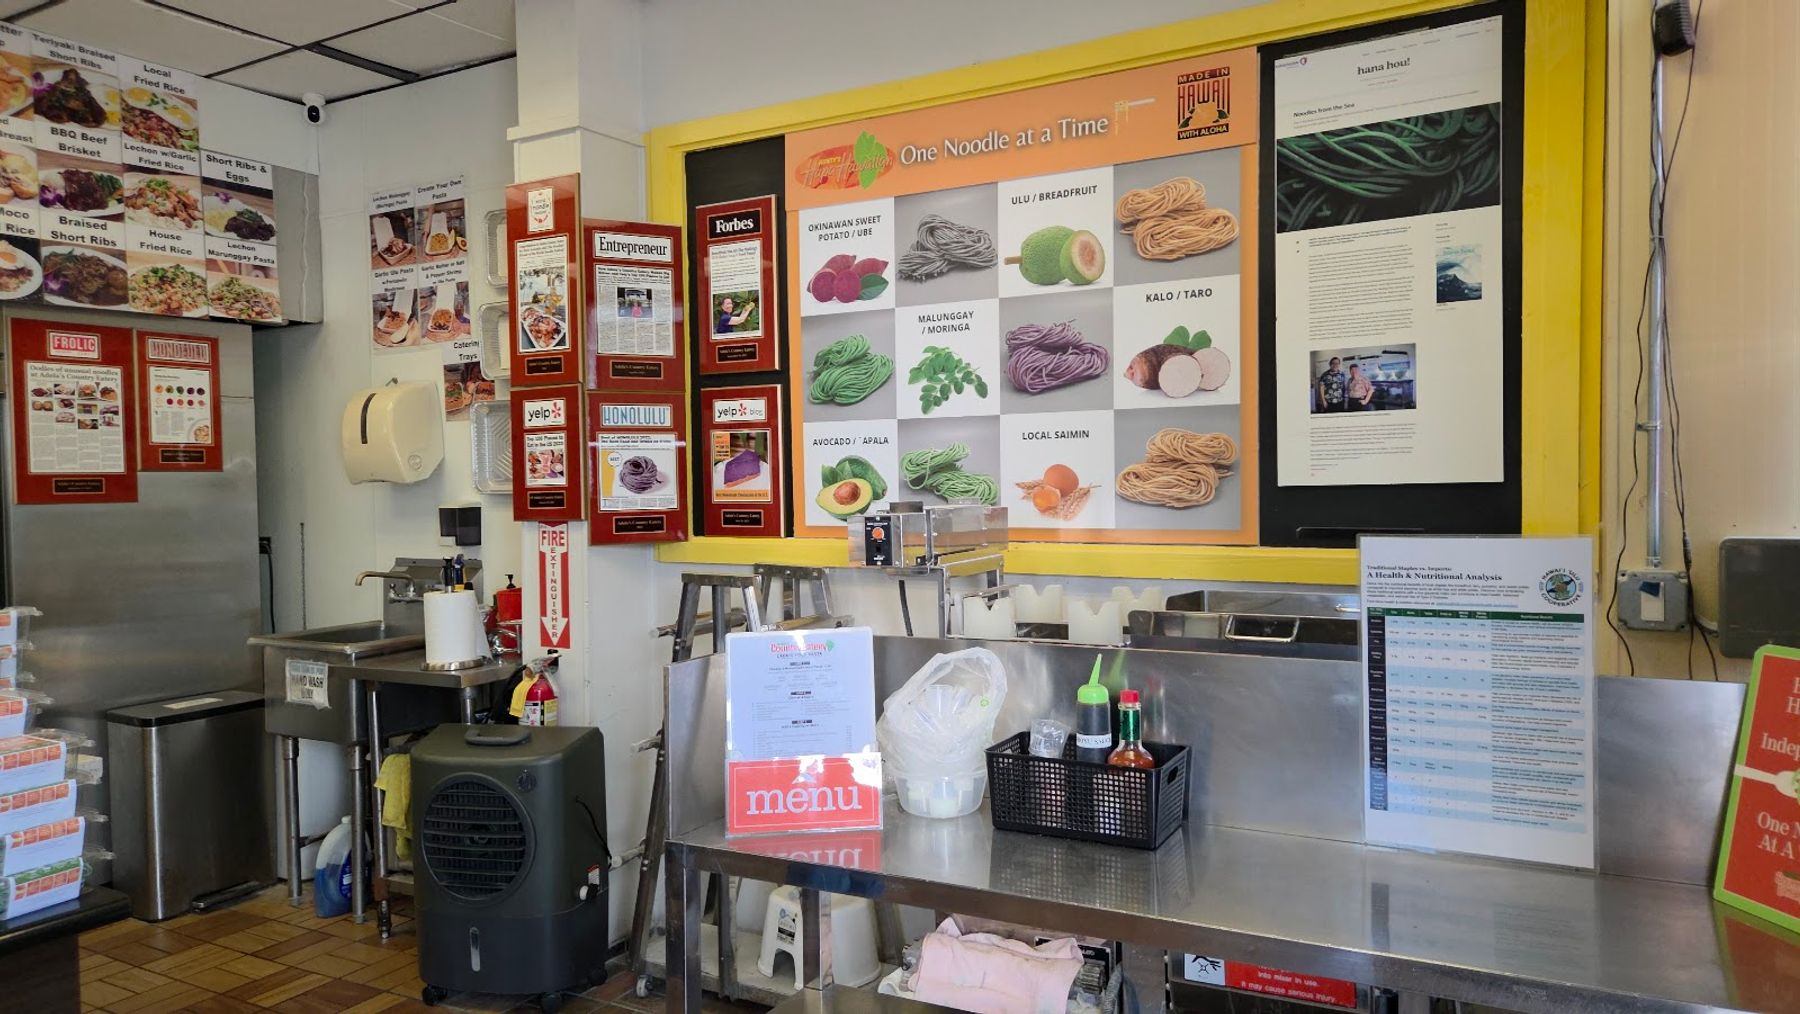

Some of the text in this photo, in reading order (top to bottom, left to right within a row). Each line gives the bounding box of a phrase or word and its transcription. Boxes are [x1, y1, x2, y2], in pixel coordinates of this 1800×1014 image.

[32, 33, 116, 62] Teriyaki Braised
[49, 50, 102, 70] Short Ribs
[1357, 57, 1411, 75] hana hou!
[143, 64, 172, 78] Local
[1178, 68, 1228, 83] MADE IN
[134, 75, 186, 95] Fried Rice
[1178, 78, 1230, 126] HAWAII
[1293, 107, 1317, 118] Noodles
[1318, 105, 1332, 113] from
[1343, 102, 1355, 110] Sea
[50, 127, 107, 145] BBQ Beef
[1179, 125, 1227, 139] WITH ALOHA
[901, 117, 1109, 165] One Noodle at a Time
[58, 143, 101, 158] Brisket
[124, 143, 158, 156] Lechon
[138, 157, 185, 171] Fried Rice
[206, 154, 267, 174] Short Ribs &
[225, 171, 250, 184] Eggs
[417, 186, 435, 194] Create
[435, 182, 449, 191] Your
[1011, 195, 1030, 205] ULU
[1039, 185, 1098, 201] BREADFRUIT
[432, 192, 447, 200] Pasta
[5, 223, 36, 236] Rice
[59, 216, 108, 231] Braised
[715, 217, 754, 233] Forbes
[808, 215, 881, 232] OKINAWAN SWEET
[50, 230, 117, 247] Short Ribs
[149, 230, 182, 242] House
[818, 231, 850, 241] POTATO
[857, 228, 873, 237] UBE
[139, 242, 192, 256] Fried Rice
[227, 242, 256, 253] Lechon
[599, 236, 668, 256] Entrepreneur
[253, 254, 275, 265] Pasta
[1145, 292, 1174, 302] KALO
[1184, 288, 1213, 299] TARO
[918, 311, 974, 323] MALUNGGAY
[927, 323, 970, 334] MORINGA
[54, 336, 95, 351] FROLIC
[459, 353, 478, 361] Trays
[527, 406, 550, 422] yelp
[603, 407, 666, 425] HONOLULU
[717, 406, 763, 418] yelp blog
[812, 437, 851, 446] AVOCADO
[1022, 430, 1090, 440] LOCAL SAIMIN
[541, 530, 565, 546] FIRE
[1375, 572, 1404, 580] Health
[1414, 572, 1463, 580] Nutritional
[1465, 574, 1503, 582] Analysis
[550, 547, 558, 638] EXTINGUISHER
[308, 676, 325, 689] WASH
[746, 785, 862, 815] menu
[1758, 811, 1790, 836] One
[1757, 834, 1795, 859] At A
[1258, 971, 1271, 979] into
[1273, 974, 1292, 982] mixer
[1249, 983, 1262, 991] may
[1264, 985, 1286, 994] cause
[1288, 989, 1314, 999] serious
